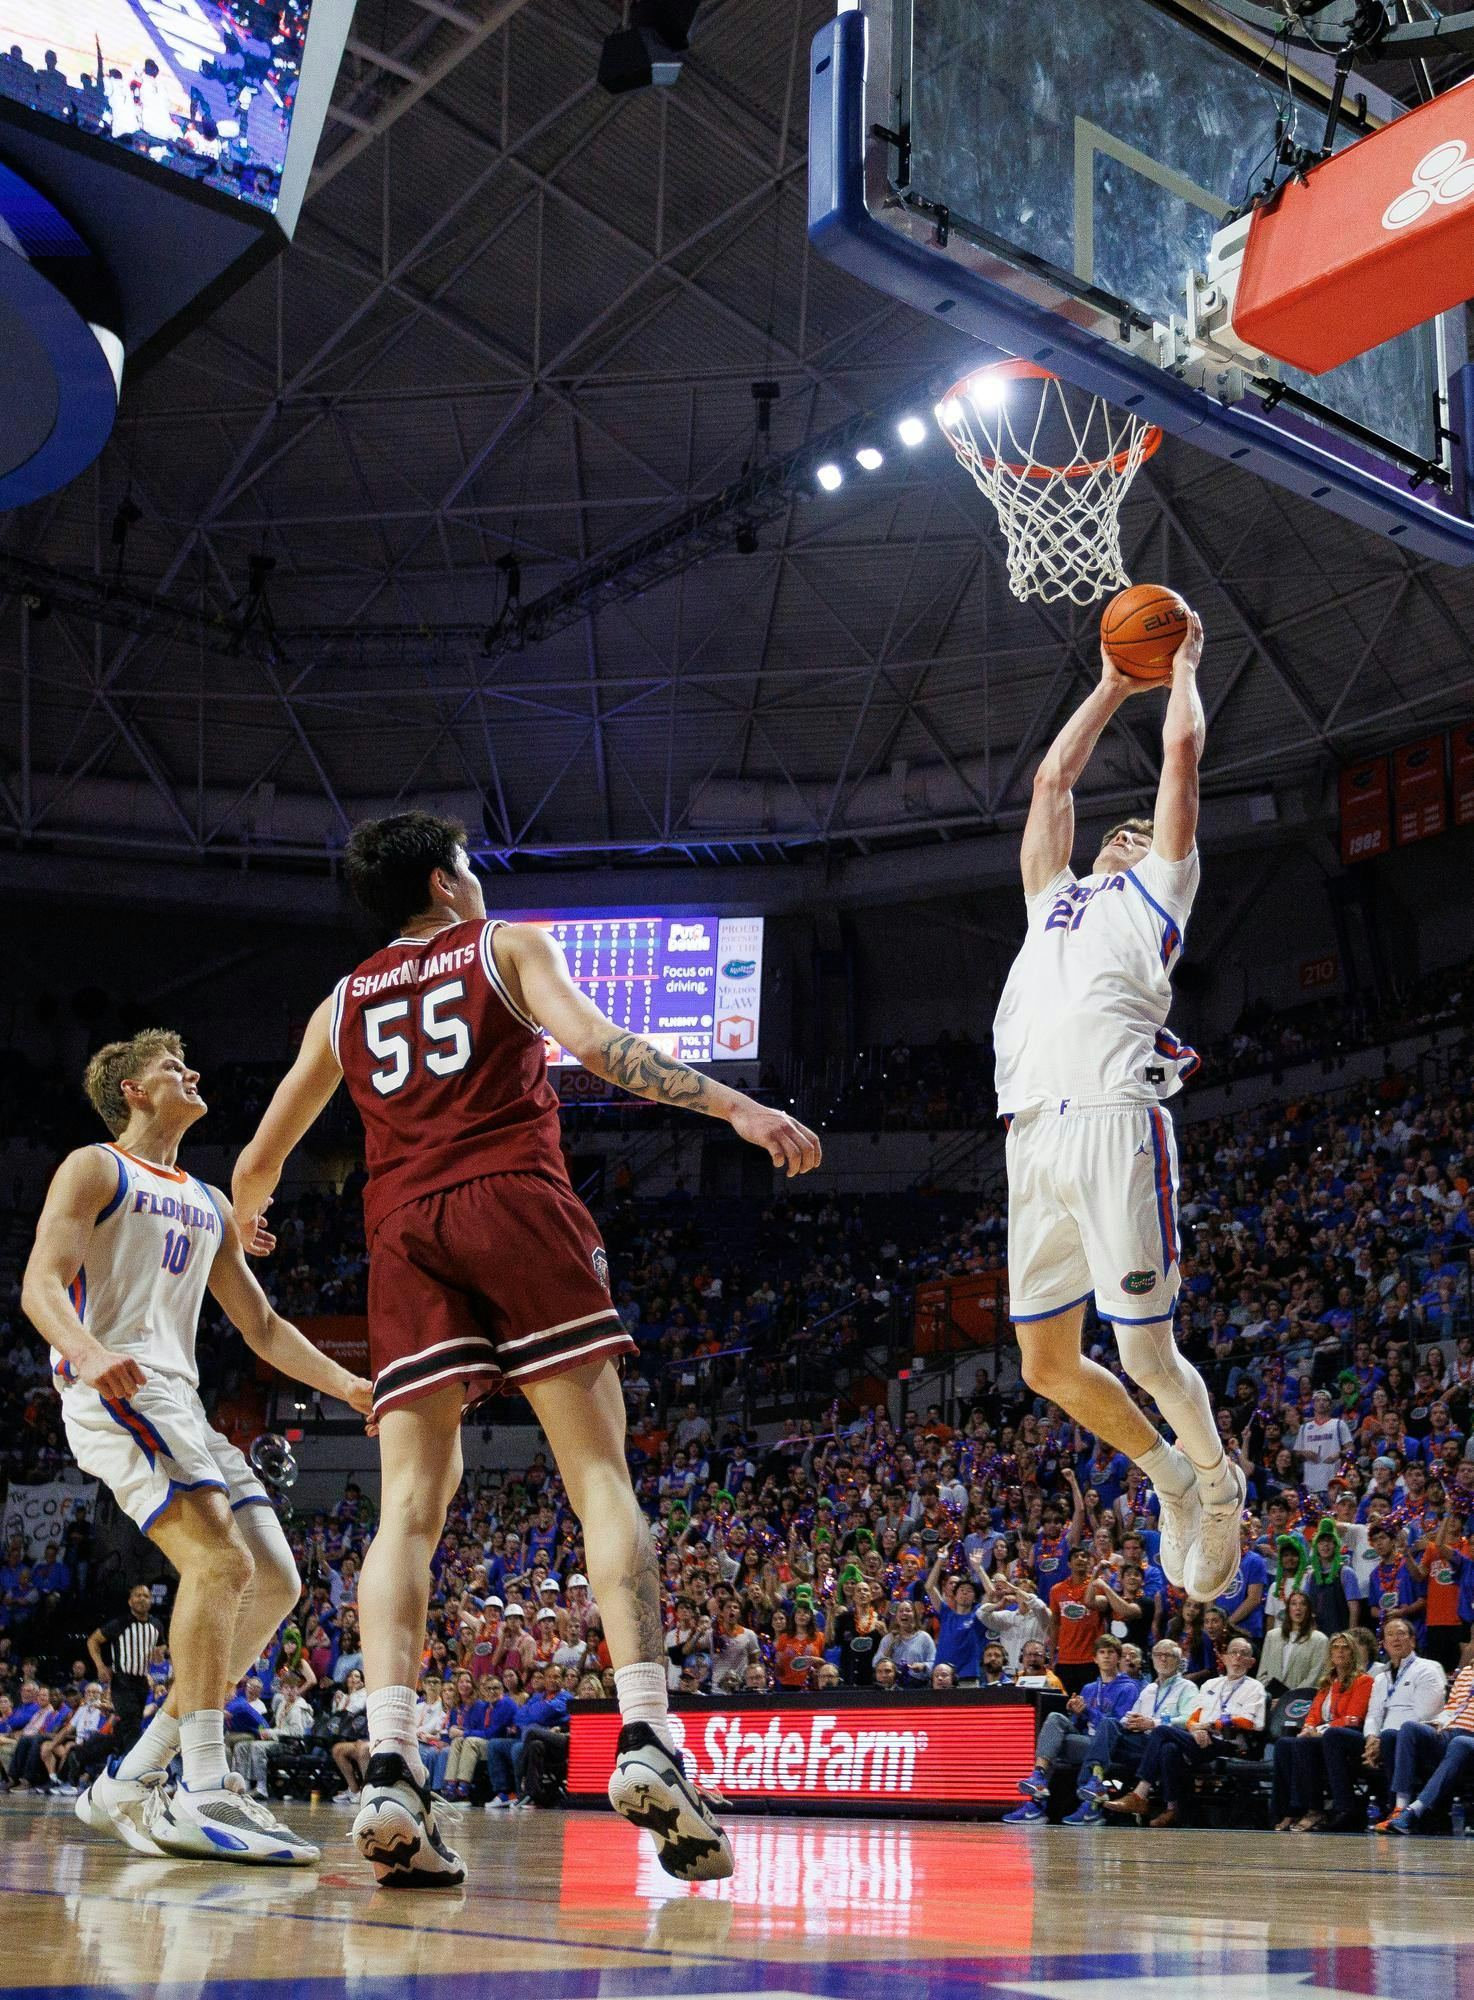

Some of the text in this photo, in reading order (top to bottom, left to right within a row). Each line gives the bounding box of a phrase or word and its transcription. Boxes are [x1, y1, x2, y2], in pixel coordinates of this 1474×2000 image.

[1044, 899, 1088, 932] 21
[352, 943, 477, 997] SHARAVJAMTS
[663, 965, 713, 978] Focus on
[666, 980, 708, 995] driving.
[364, 980, 473, 1097] 55
[1059, 1098, 1071, 1115] F
[161, 1228, 191, 1276] 10
